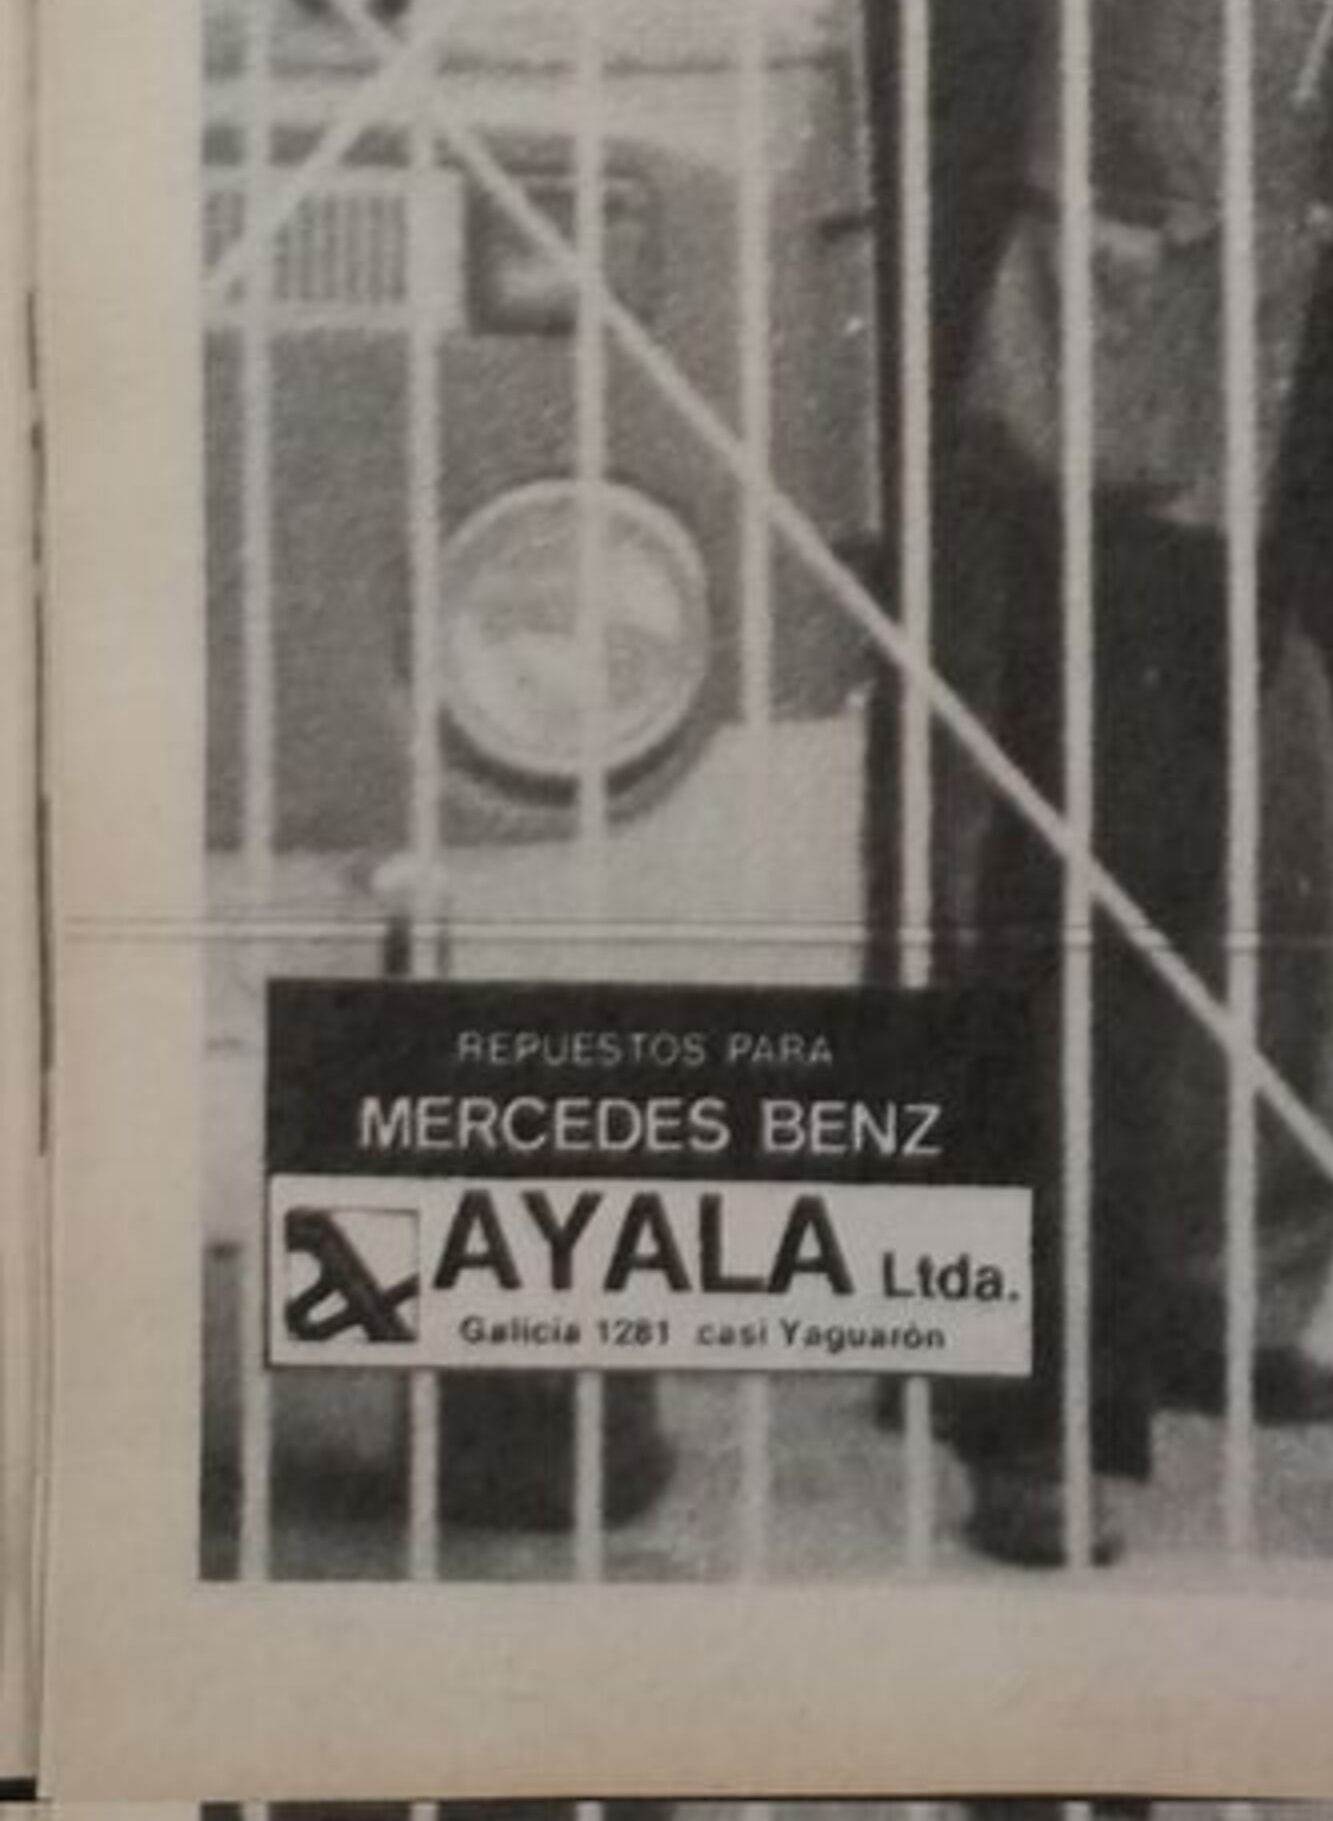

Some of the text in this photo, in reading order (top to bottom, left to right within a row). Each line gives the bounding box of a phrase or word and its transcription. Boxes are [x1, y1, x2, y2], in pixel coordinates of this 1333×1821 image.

[458, 1030, 834, 1067] REPUESTOS PARA
[359, 1096, 943, 1156] MERCEDES BENZ
[432, 1189, 1020, 1304] AYALA Ltda.
[460, 1317, 944, 1354] Galicia 1281 casi Yaguarón
